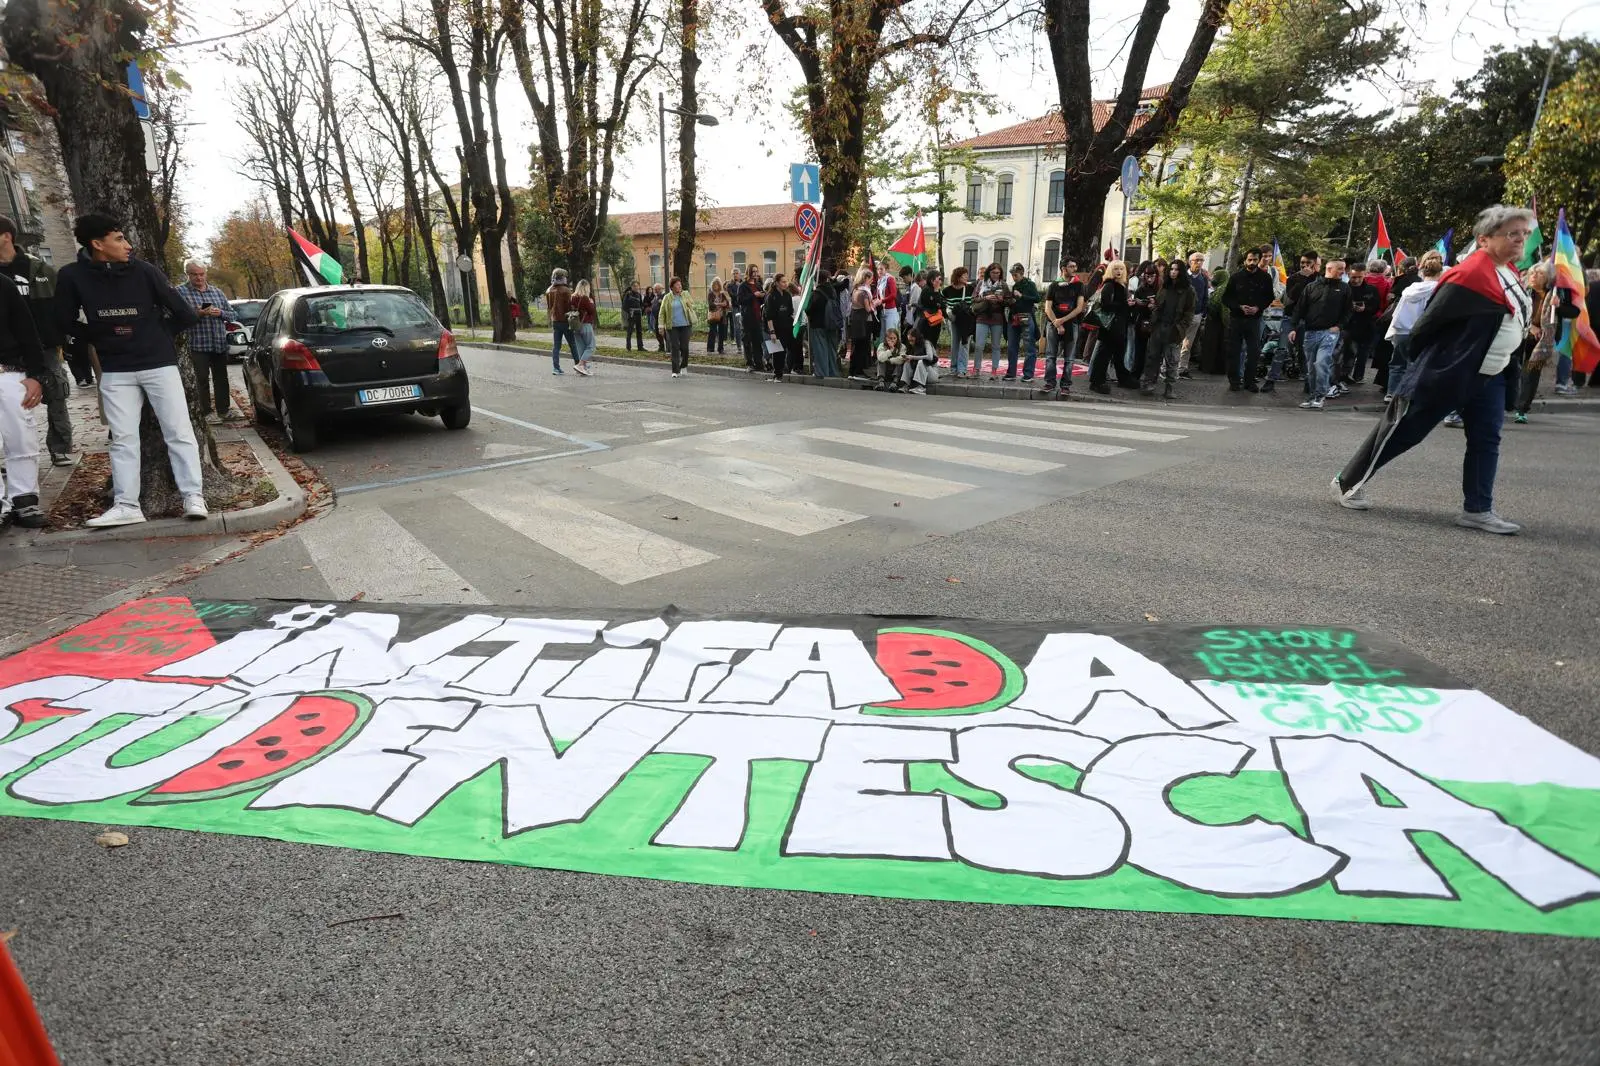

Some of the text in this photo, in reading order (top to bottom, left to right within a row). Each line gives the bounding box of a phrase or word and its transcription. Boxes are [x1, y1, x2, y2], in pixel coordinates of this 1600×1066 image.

[366, 386, 413, 401] DC 700RH
[1194, 651, 1406, 680] ISRAEL
[1331, 681, 1442, 706] RED
[1259, 699, 1424, 734] CARD
